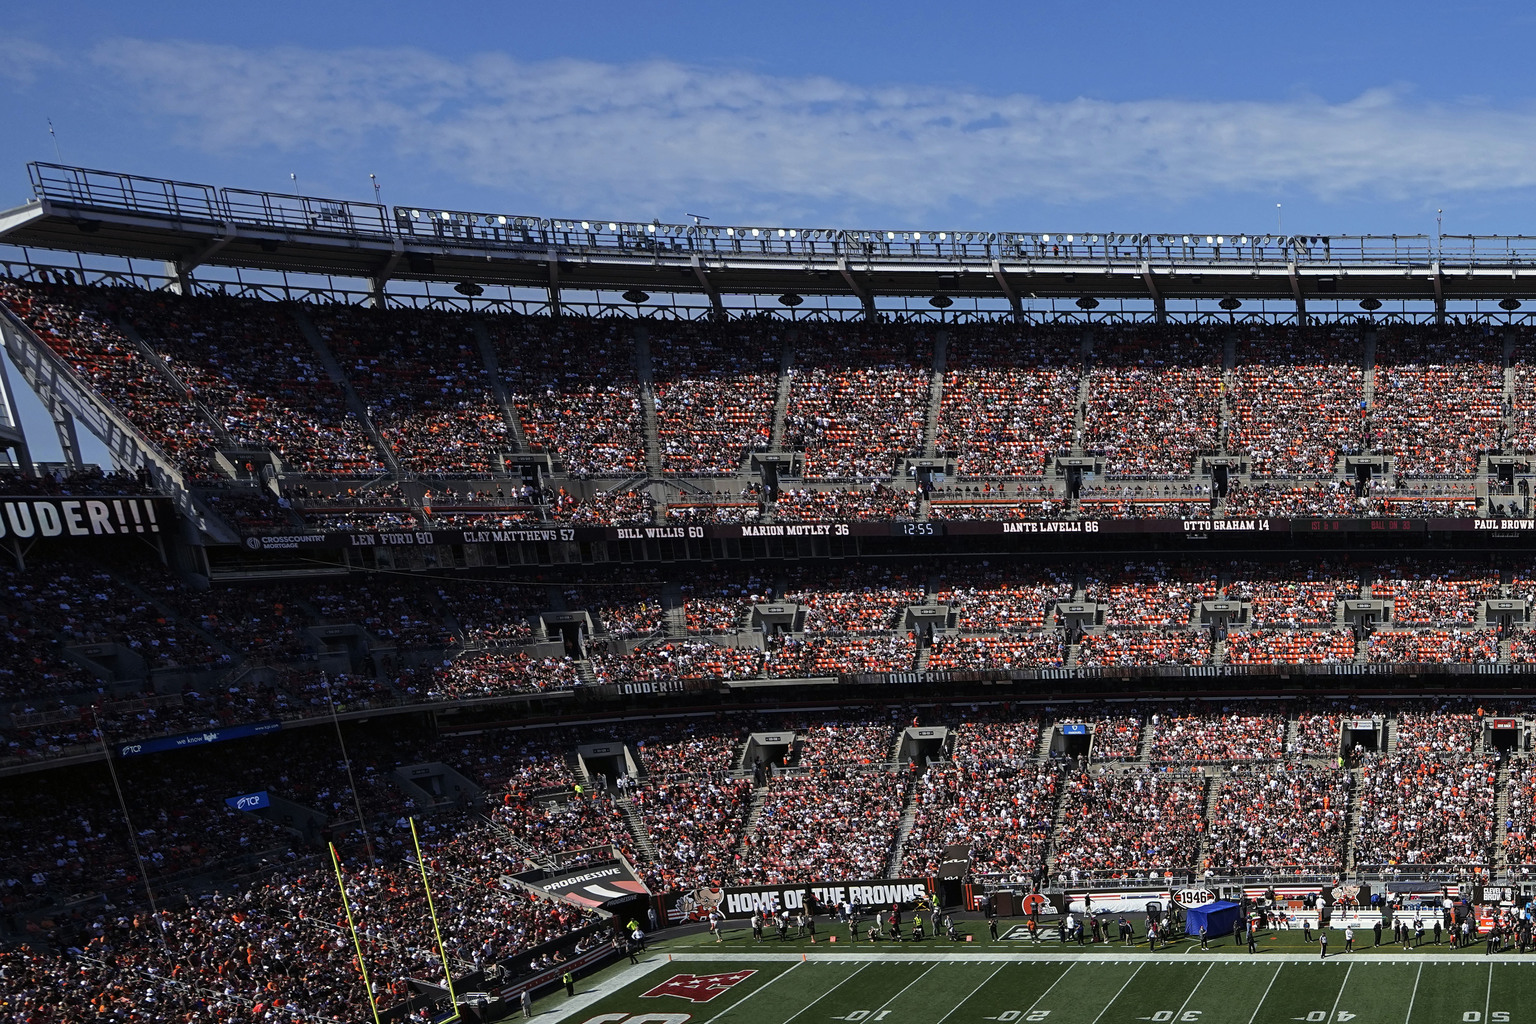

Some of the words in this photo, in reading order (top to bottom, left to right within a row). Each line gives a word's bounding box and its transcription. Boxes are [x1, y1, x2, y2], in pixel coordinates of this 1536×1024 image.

[742, 526, 784, 537] MARION
[786, 525, 830, 536] MOTLEY
[835, 524, 849, 535] 36
[903, 523, 934, 535] 12:55
[1003, 522, 1038, 533] DANTE
[1040, 521, 1081, 532] LAVELLI
[1084, 521, 1099, 532] 86
[1184, 520, 1210, 531] OTTO
[1213, 520, 1255, 531] GRAHAM
[1258, 520, 1270, 531] 14
[1474, 519, 1498, 530] PAUL
[1501, 519, 1535, 530] BROWN
[262, 535, 325, 543] CROSSCOUNTRY
[350, 534, 375, 546] LEN
[381, 533, 413, 545] FORD
[416, 532, 434, 545] 80
[463, 531, 490, 542] CLAY
[492, 530, 556, 542] MATTHEWS
[560, 529, 575, 541] 57
[617, 528, 642, 539] BILL
[645, 527, 685, 538] WILLIS
[688, 527, 704, 538] 60
[617, 681, 684, 694] LOUDER!!!
[130, 745, 142, 754] TCP
[176, 738, 186, 746] we
[187, 736, 203, 745] know
[246, 796, 259, 807] TCP
[543, 868, 622, 892] PROGRESSIVE
[727, 893, 781, 914] HOME
[784, 890, 805, 910] OF
[811, 888, 846, 907] THE
[848, 884, 925, 905] BROWNS
[1180, 892, 1207, 904] 1946
